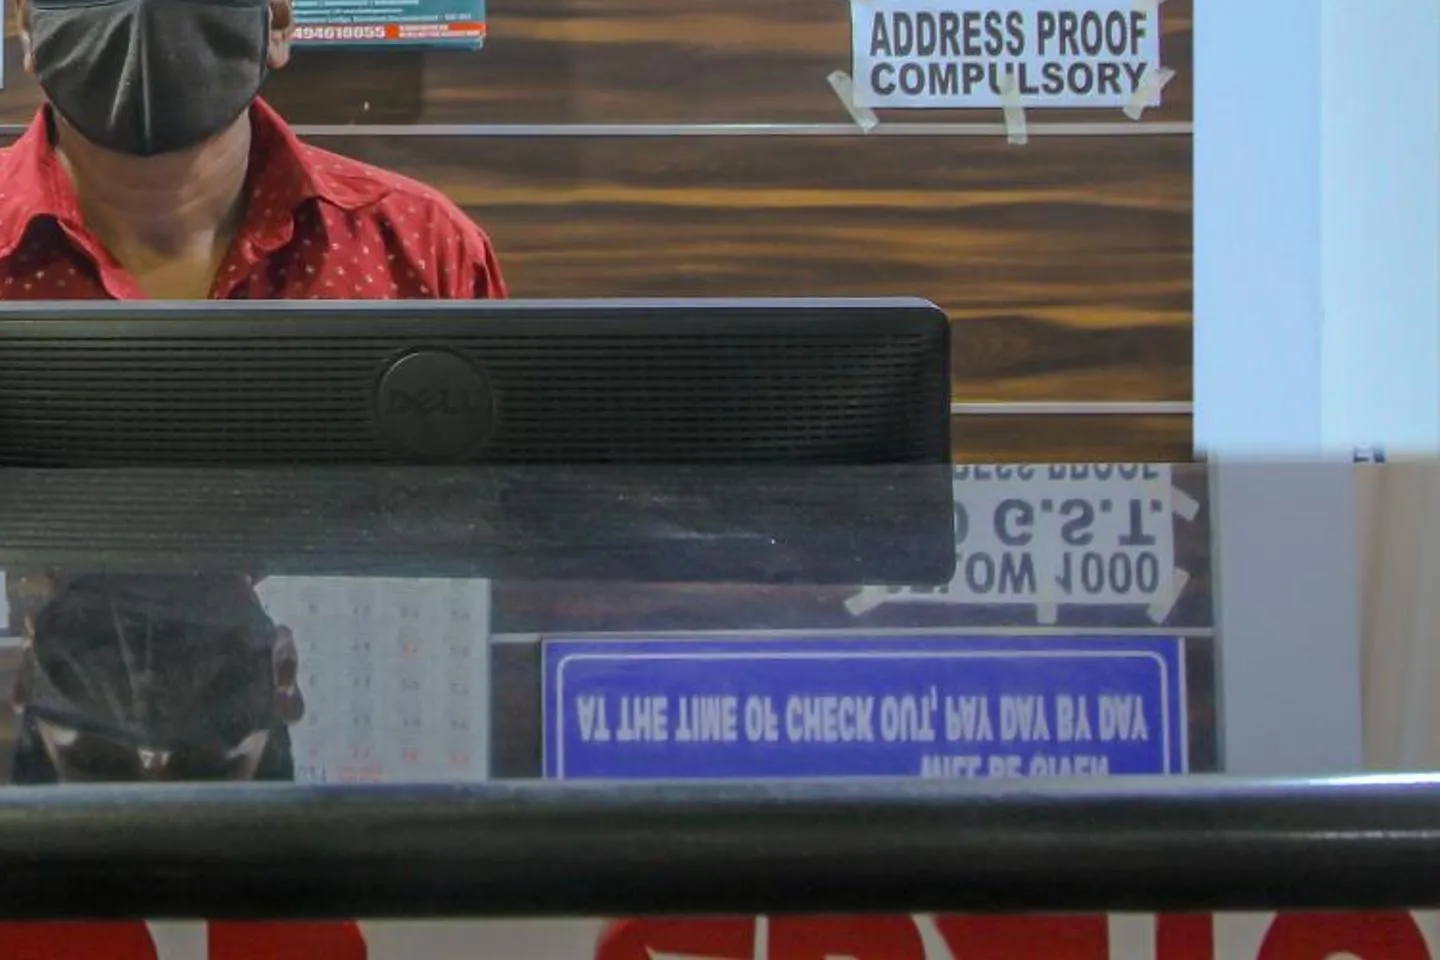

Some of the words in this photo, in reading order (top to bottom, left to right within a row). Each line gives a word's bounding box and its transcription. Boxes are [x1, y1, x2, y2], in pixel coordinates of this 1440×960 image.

[870, 11, 1025, 57] ADDRESS
[1037, 10, 1147, 57] PROOF
[871, 62, 1148, 96] COMPULSORY
